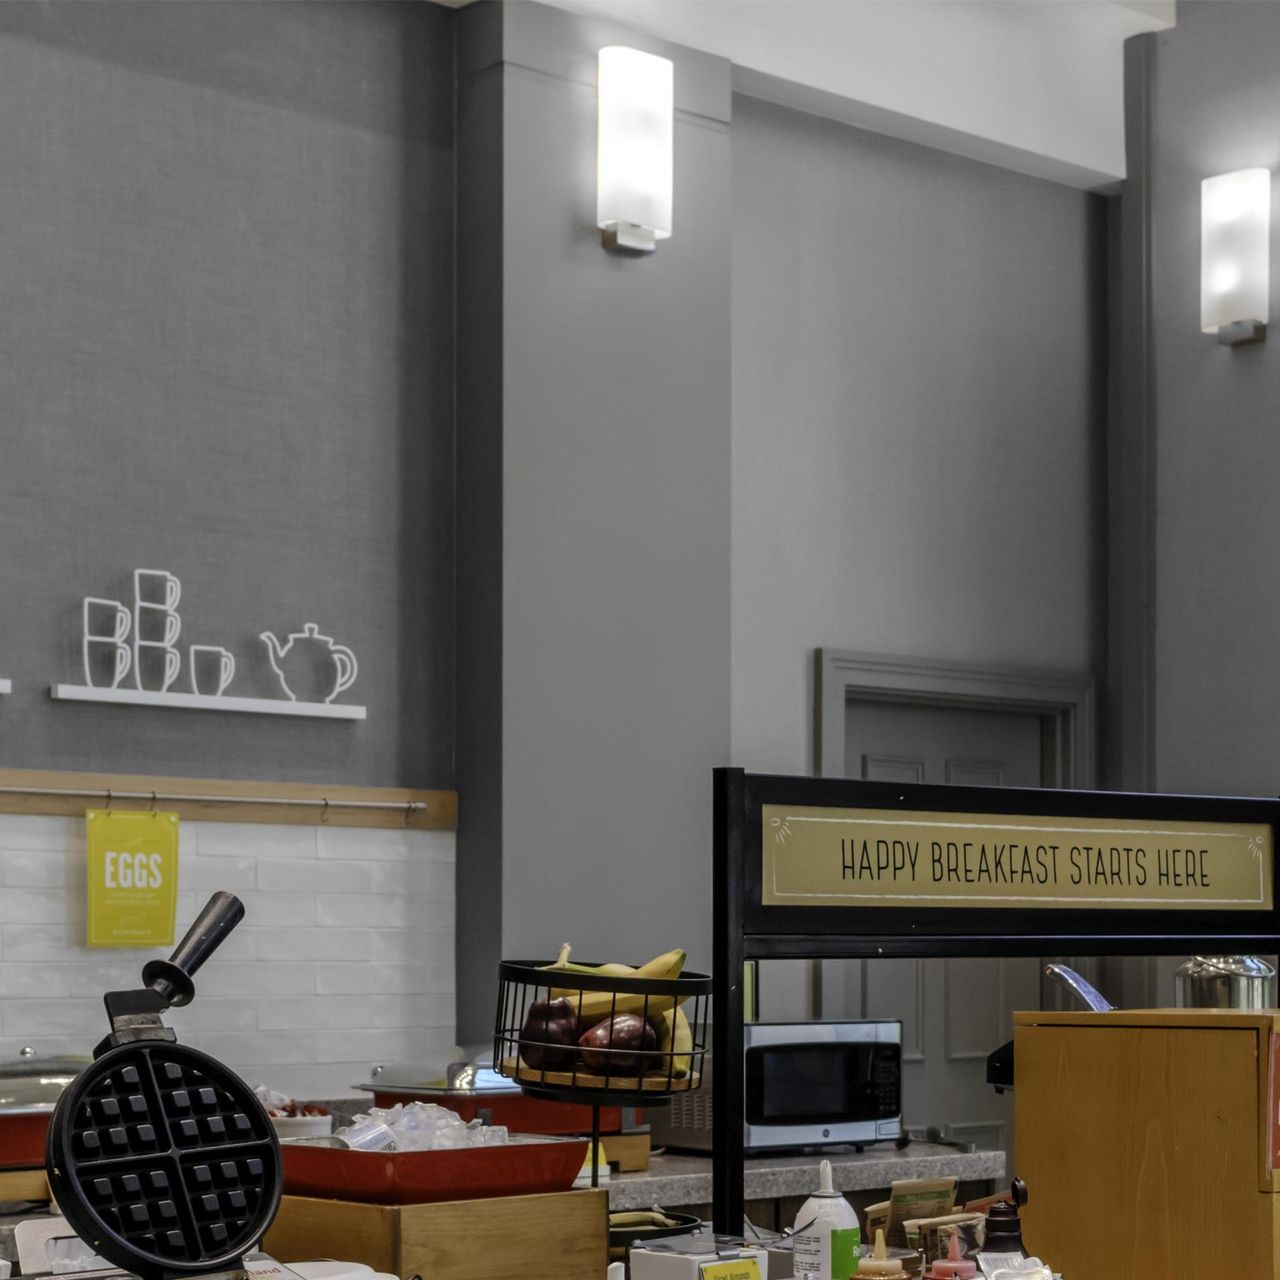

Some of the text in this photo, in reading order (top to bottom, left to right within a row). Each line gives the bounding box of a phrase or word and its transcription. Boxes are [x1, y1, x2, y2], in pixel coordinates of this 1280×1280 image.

[104, 851, 163, 889] EGGS
[841, 838, 1211, 888] HAPPY BREAKFAST STARTS HERE
